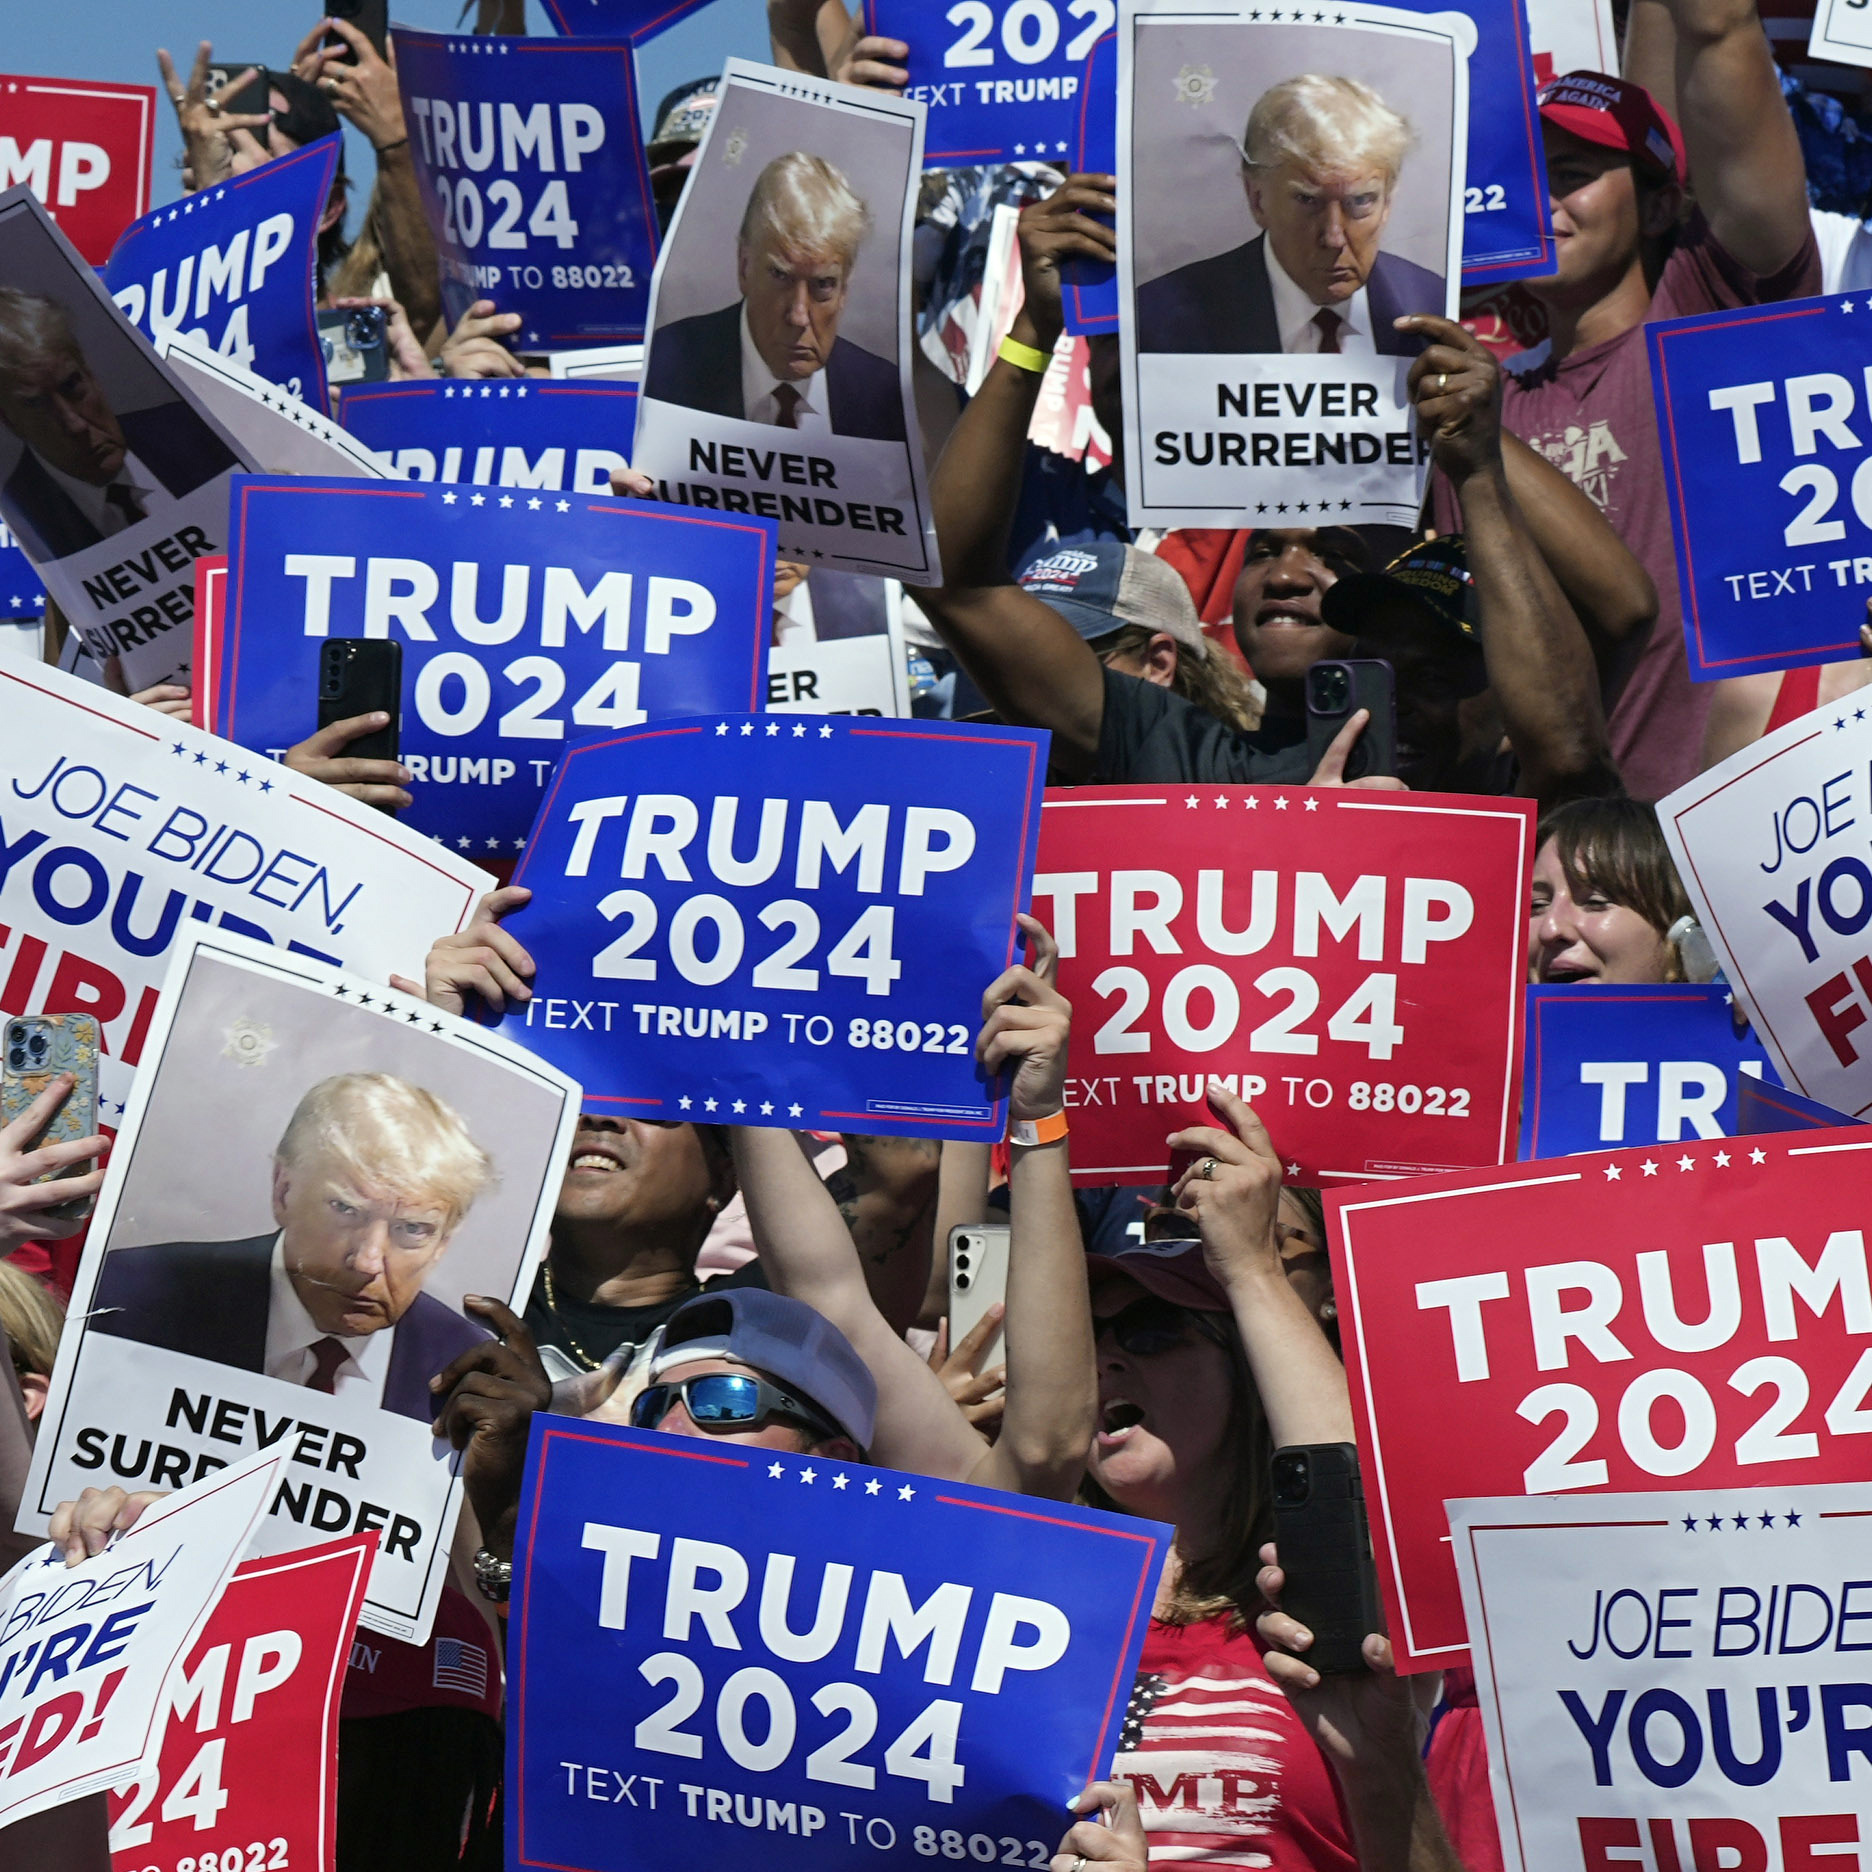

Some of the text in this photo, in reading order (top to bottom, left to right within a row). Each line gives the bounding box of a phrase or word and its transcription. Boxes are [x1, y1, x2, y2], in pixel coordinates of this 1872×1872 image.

[943, 2, 1115, 67] 202
[975, 76, 1079, 105] TRUMP
[412, 101, 606, 174] TRUMP
[441, 180, 579, 250] 2024
[507, 264, 635, 290] TO 88022
[1215, 381, 1379, 419] NEVER
[689, 437, 838, 491] NEVER
[649, 474, 908, 537] SURRENDER
[81, 525, 219, 614] NEVER
[284, 553, 718, 656] TRUMP
[1723, 563, 1816, 602] TEXT
[412, 654, 650, 741] 024
[398, 753, 516, 787] RUMP
[10, 754, 365, 935] JOE BIDEN,
[562, 793, 978, 897] TRUMP
[1760, 767, 1856, 876] JOE
[592, 889, 902, 998] 2024
[1032, 867, 1476, 966] TRUMP
[526, 998, 969, 1055] TEXT TRUMP TO 88022
[1091, 965, 1405, 1061] 2024
[1062, 1076, 1471, 1118] EXT TO 88022
[165, 1387, 368, 1481] NEVER
[581, 1520, 1071, 1696] TRUMP
[1566, 1586, 1699, 1662] JOE
[633, 1652, 966, 1807] 2024
[559, 1761, 1049, 1871] TEXT TRUMP TO 88022
